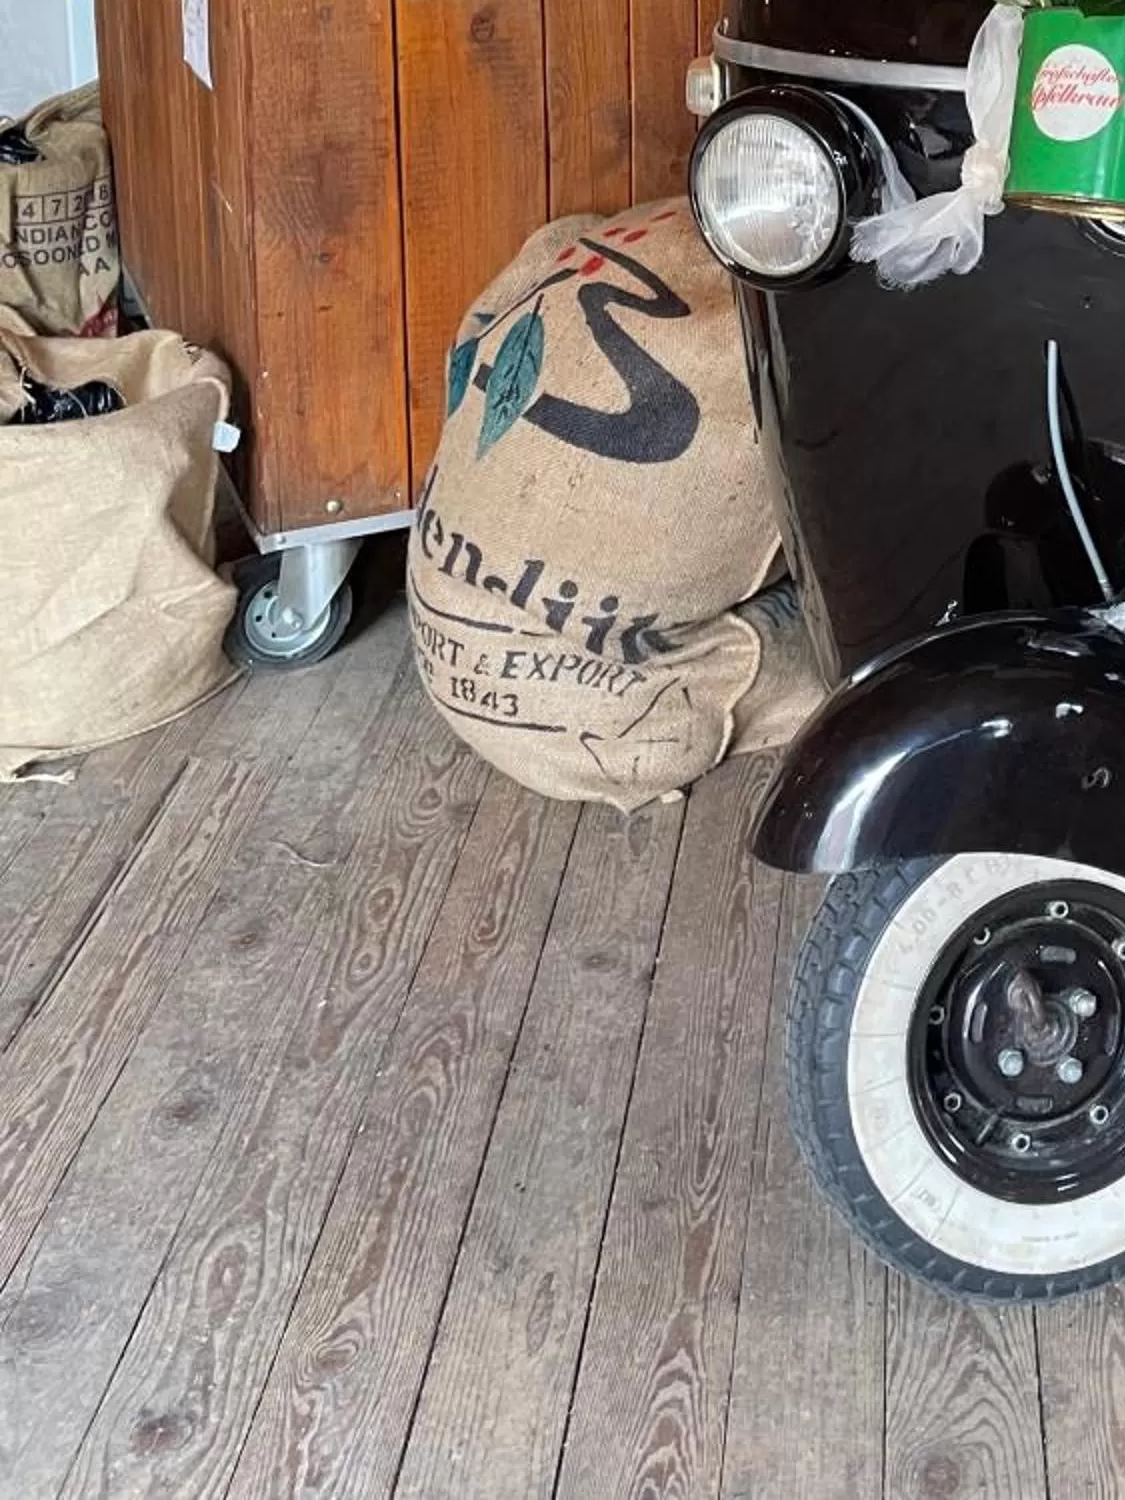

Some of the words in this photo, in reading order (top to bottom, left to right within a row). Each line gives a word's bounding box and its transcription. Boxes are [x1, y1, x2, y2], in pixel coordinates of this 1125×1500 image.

[18, 224, 82, 244] NDIAN
[501, 650, 648, 697] EXPORT
[450, 676, 519, 717] 1843
